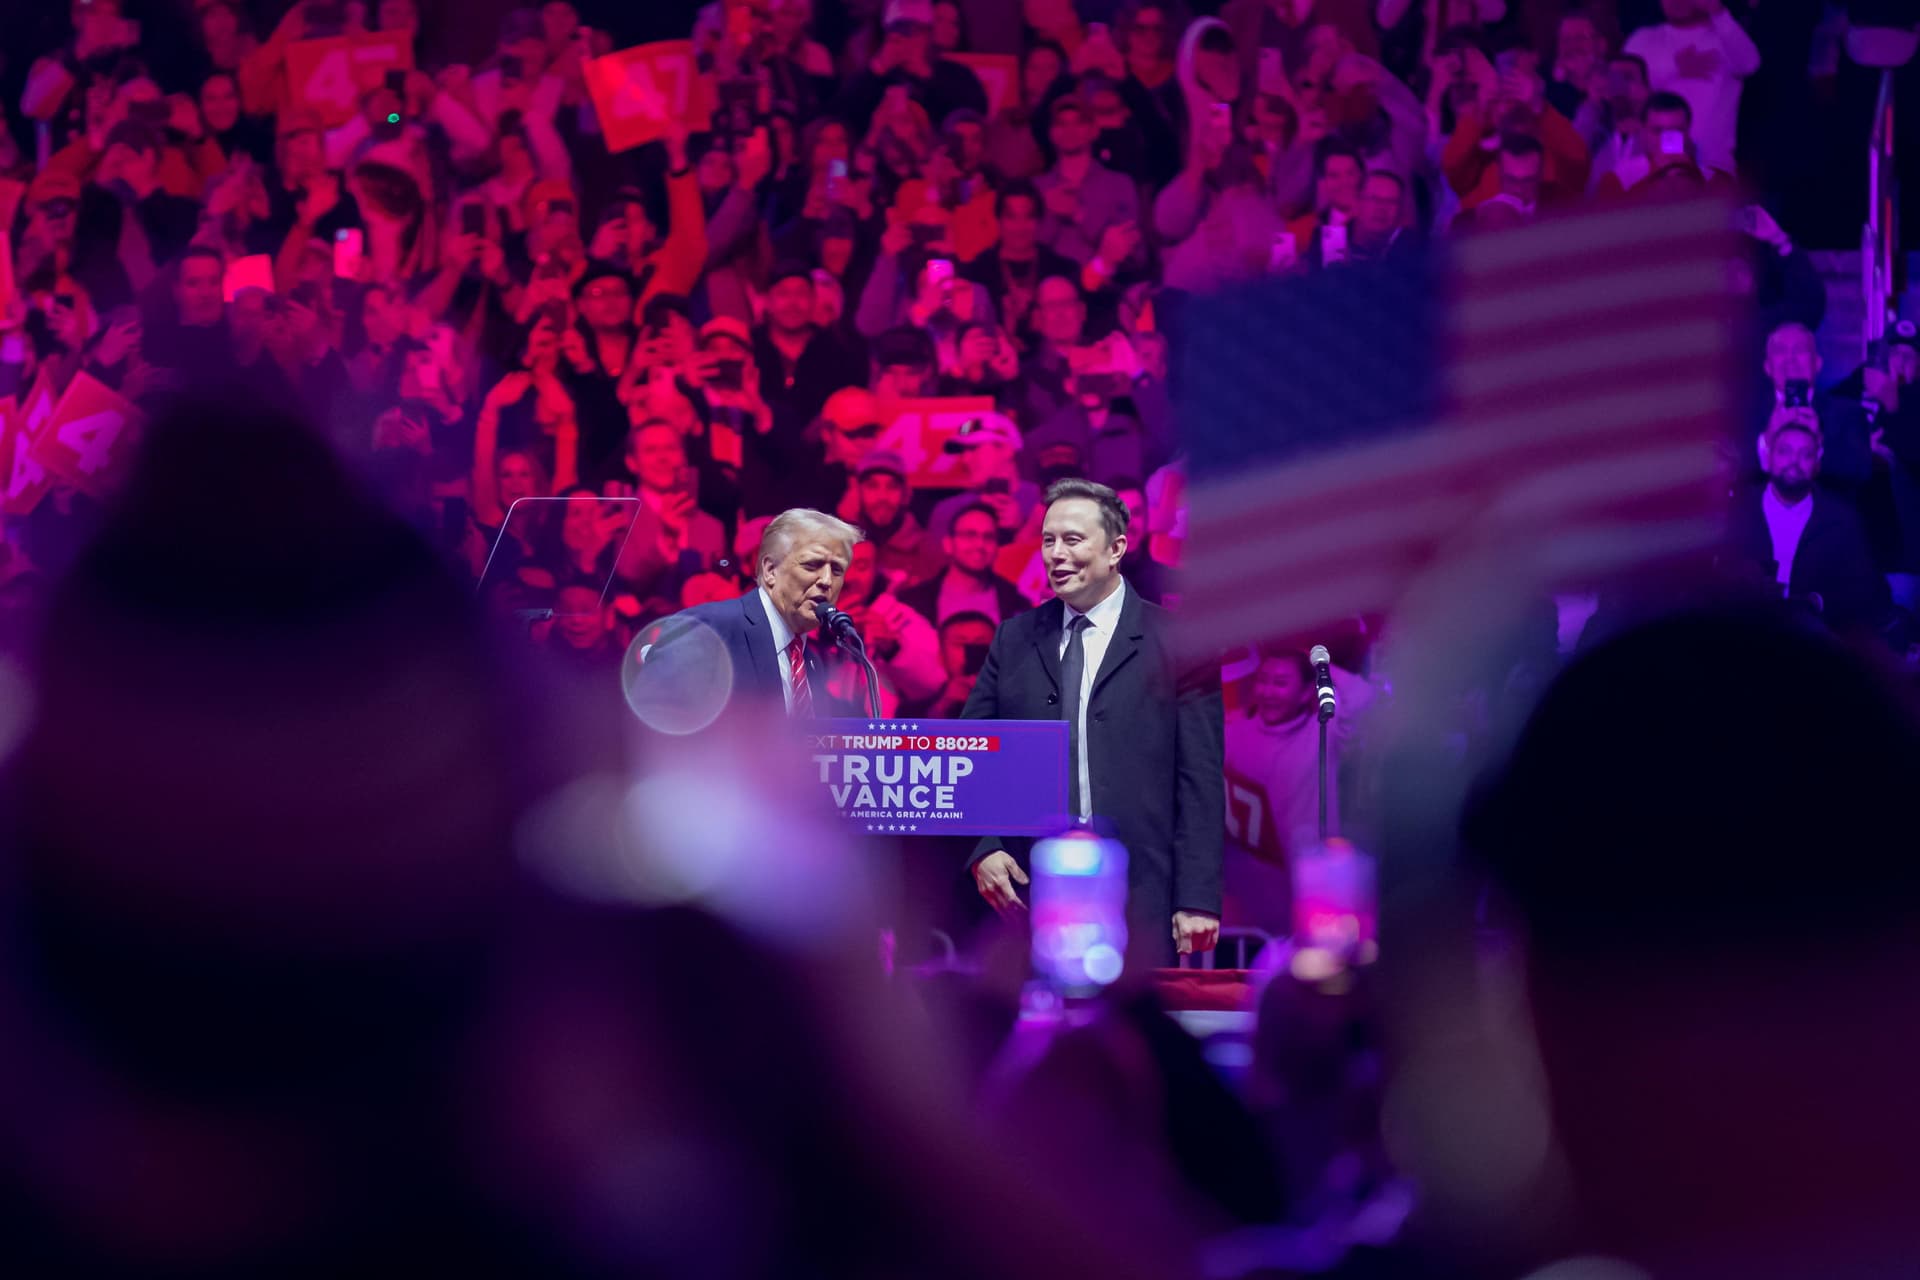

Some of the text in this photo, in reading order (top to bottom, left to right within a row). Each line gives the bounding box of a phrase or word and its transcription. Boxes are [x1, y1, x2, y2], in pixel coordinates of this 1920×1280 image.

[611, 55, 688, 121] 47
[807, 735, 989, 751] EXT TRUMP TO 88022
[813, 754, 974, 784] TRUMP
[830, 784, 955, 809] VANCE
[850, 811, 893, 819] AMERICA
[896, 811, 927, 819] GREAT
[930, 811, 963, 820] AGAIN!
